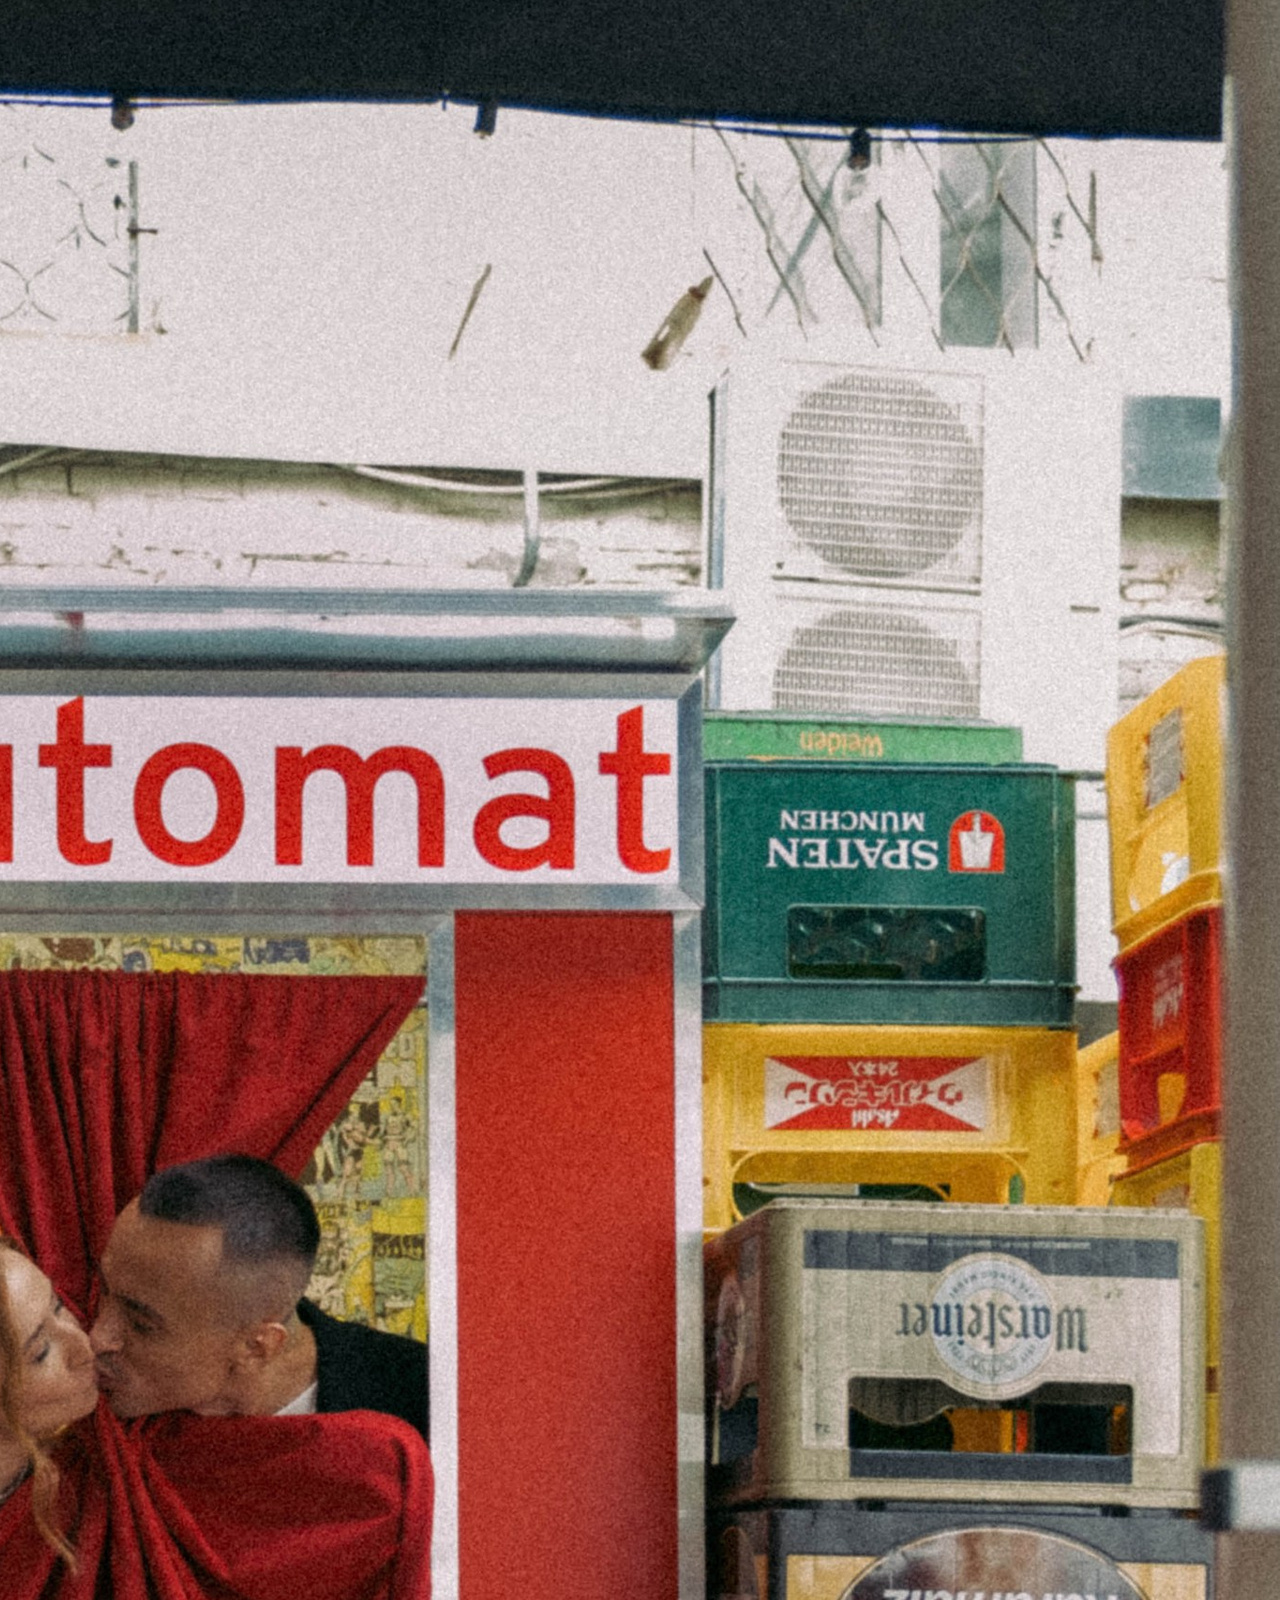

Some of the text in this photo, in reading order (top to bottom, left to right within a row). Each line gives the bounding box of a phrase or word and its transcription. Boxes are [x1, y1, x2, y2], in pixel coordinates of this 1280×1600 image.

[780, 809, 926, 834] MÜNCHEN
[766, 838, 939, 871] SPATEN
[850, 1108, 900, 1129] Asahi
[894, 1301, 1089, 1354] Warsteiner
